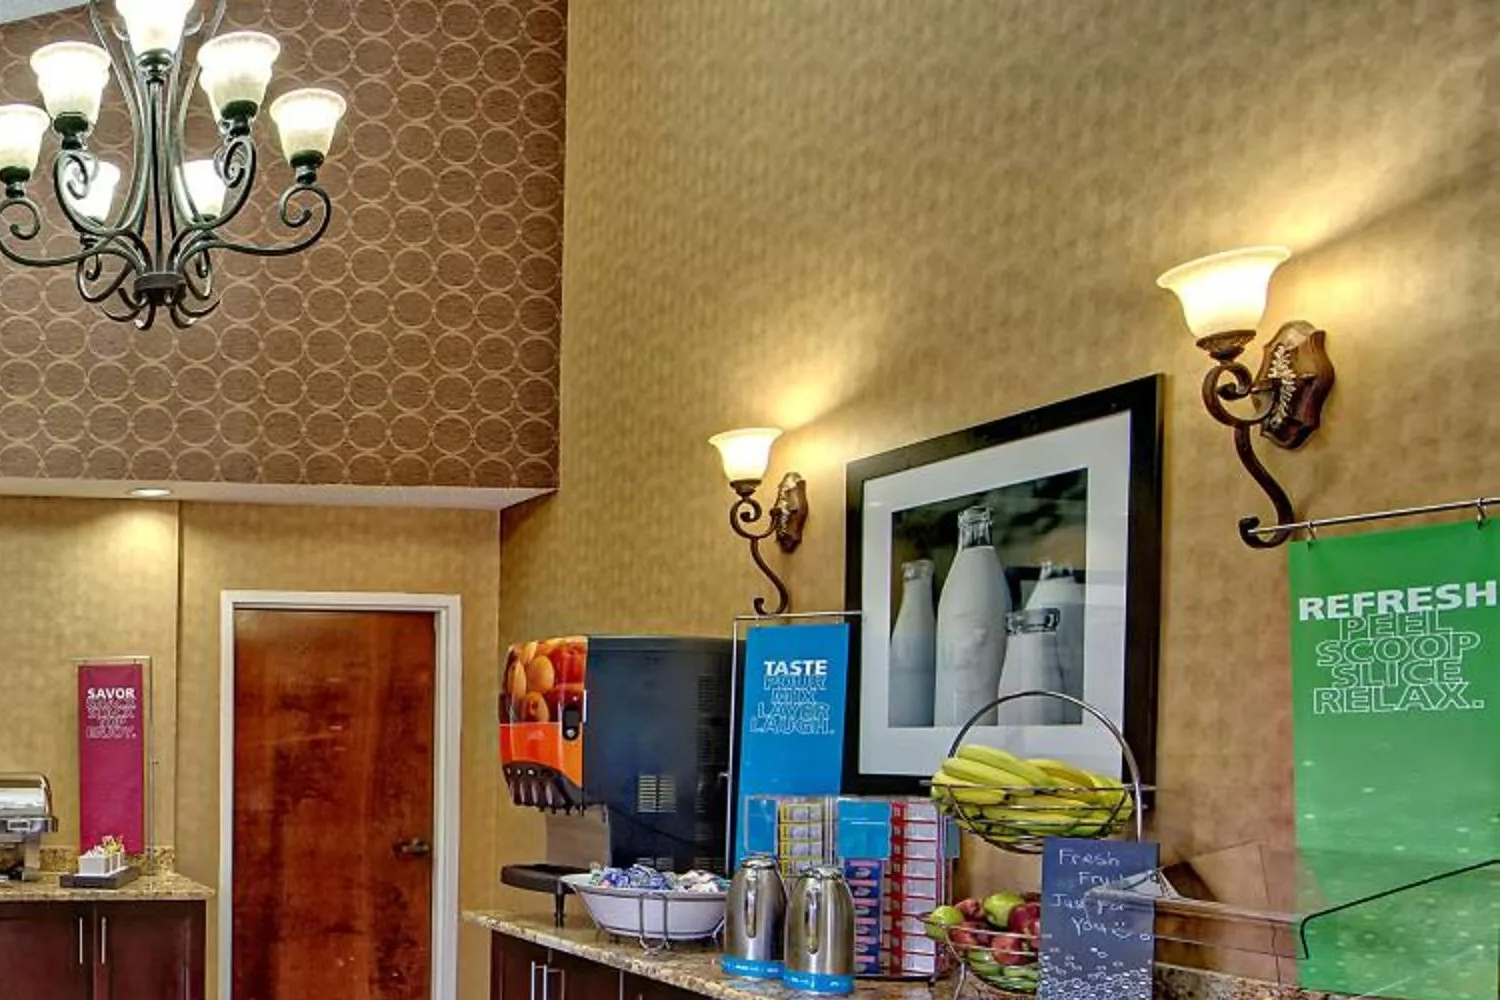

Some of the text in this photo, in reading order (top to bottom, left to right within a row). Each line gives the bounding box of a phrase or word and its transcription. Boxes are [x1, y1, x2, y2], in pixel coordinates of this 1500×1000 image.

[1299, 580, 1497, 621] REFRESH
[1339, 604, 1453, 641] PEEL
[1315, 631, 1481, 667] SCOOP
[763, 659, 828, 676] TASTE
[1332, 658, 1464, 691] SLICE
[86, 687, 136, 700] SAVOR
[1313, 681, 1485, 715] RELAX.
[1059, 847, 1121, 866] Fresh
[1071, 916, 1108, 937] You
